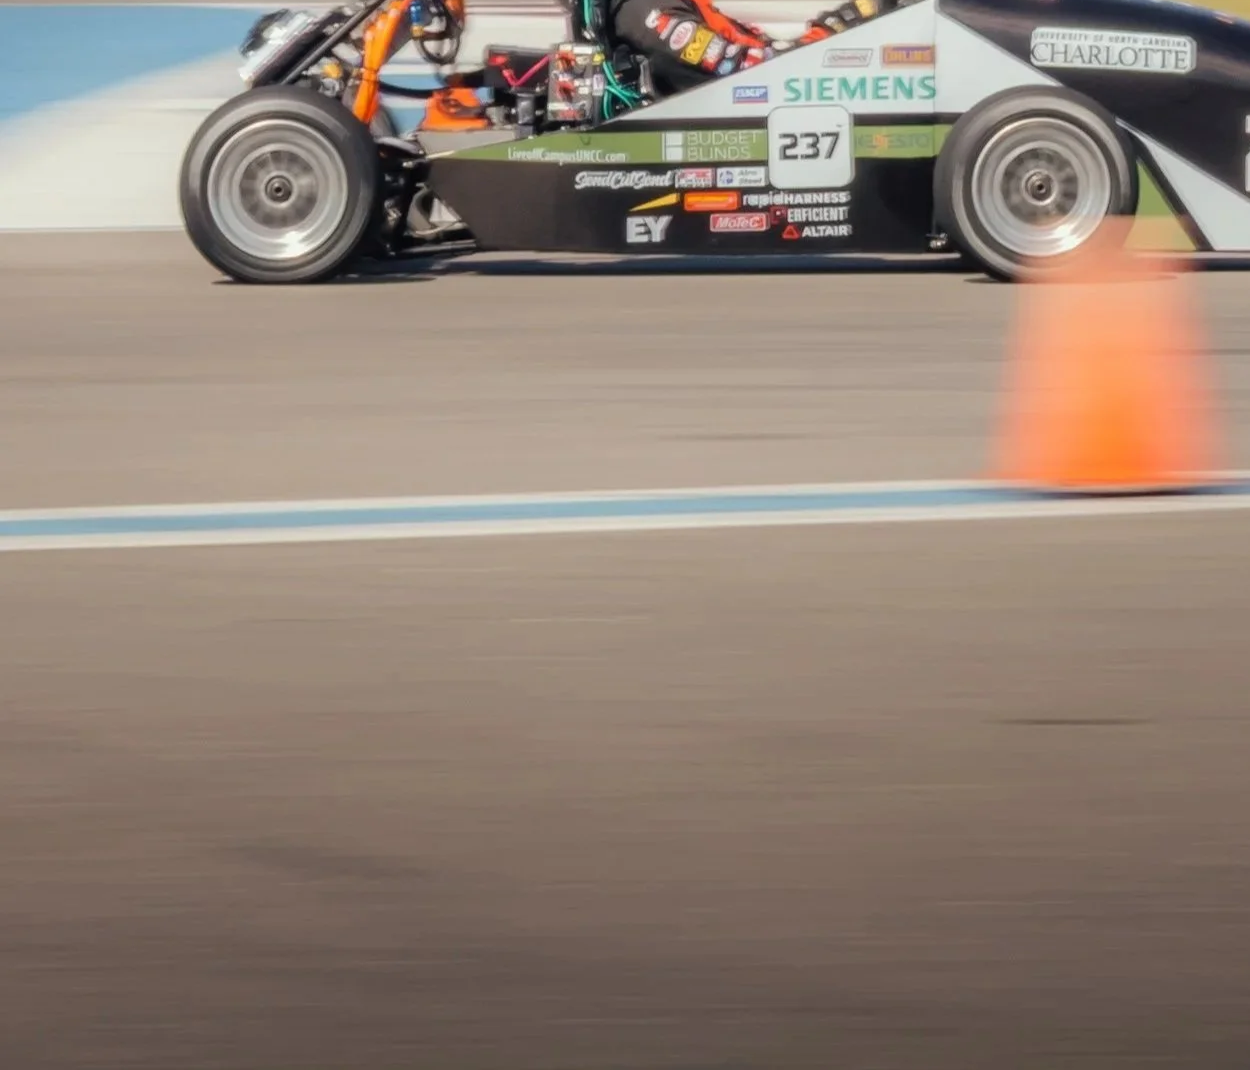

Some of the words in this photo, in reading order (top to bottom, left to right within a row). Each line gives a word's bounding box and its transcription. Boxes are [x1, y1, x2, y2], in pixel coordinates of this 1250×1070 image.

[1031, 42, 1189, 71] CHARLOTTE
[783, 75, 938, 103] SIEMENS
[687, 130, 762, 145] BUDGET
[778, 131, 841, 161] 237
[687, 146, 752, 161] BLINDS
[574, 170, 672, 190] SendCutSend
[626, 215, 673, 244] EY
[715, 217, 761, 230] MoTeC
[801, 225, 853, 238] ALTAIR
